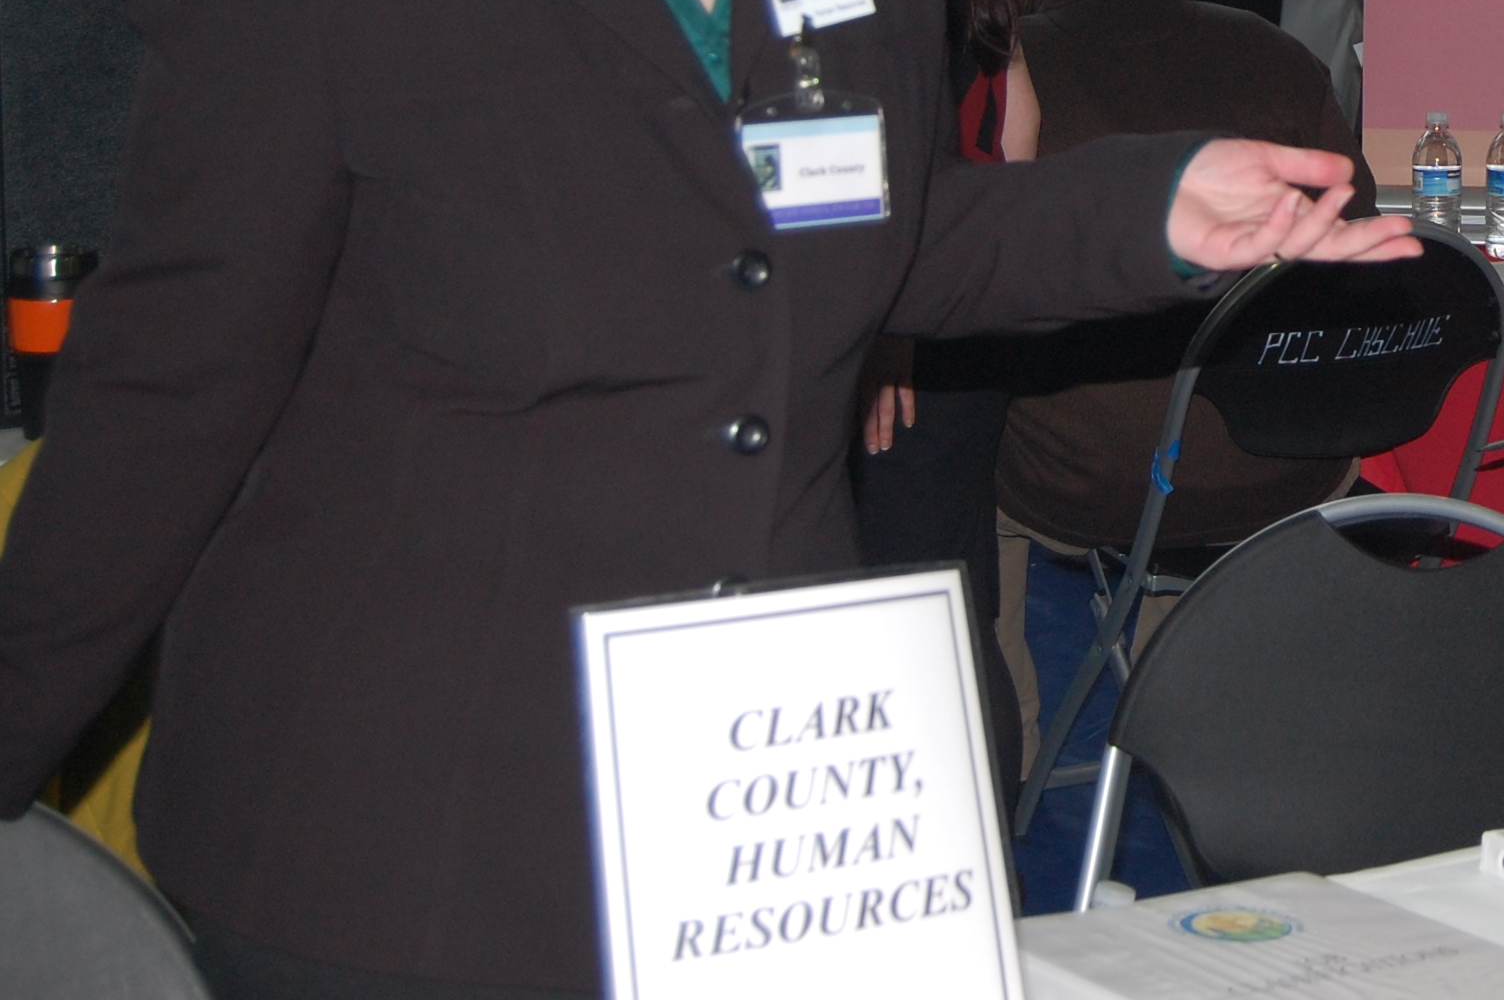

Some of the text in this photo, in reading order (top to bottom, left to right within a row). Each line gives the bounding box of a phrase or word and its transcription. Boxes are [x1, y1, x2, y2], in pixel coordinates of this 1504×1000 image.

[1257, 330, 1324, 366] PCC
[729, 689, 894, 752] CLARK
[706, 750, 924, 822] COUNTY,
[726, 814, 921, 887] HUMAN
[672, 868, 975, 962] RESOURCES
